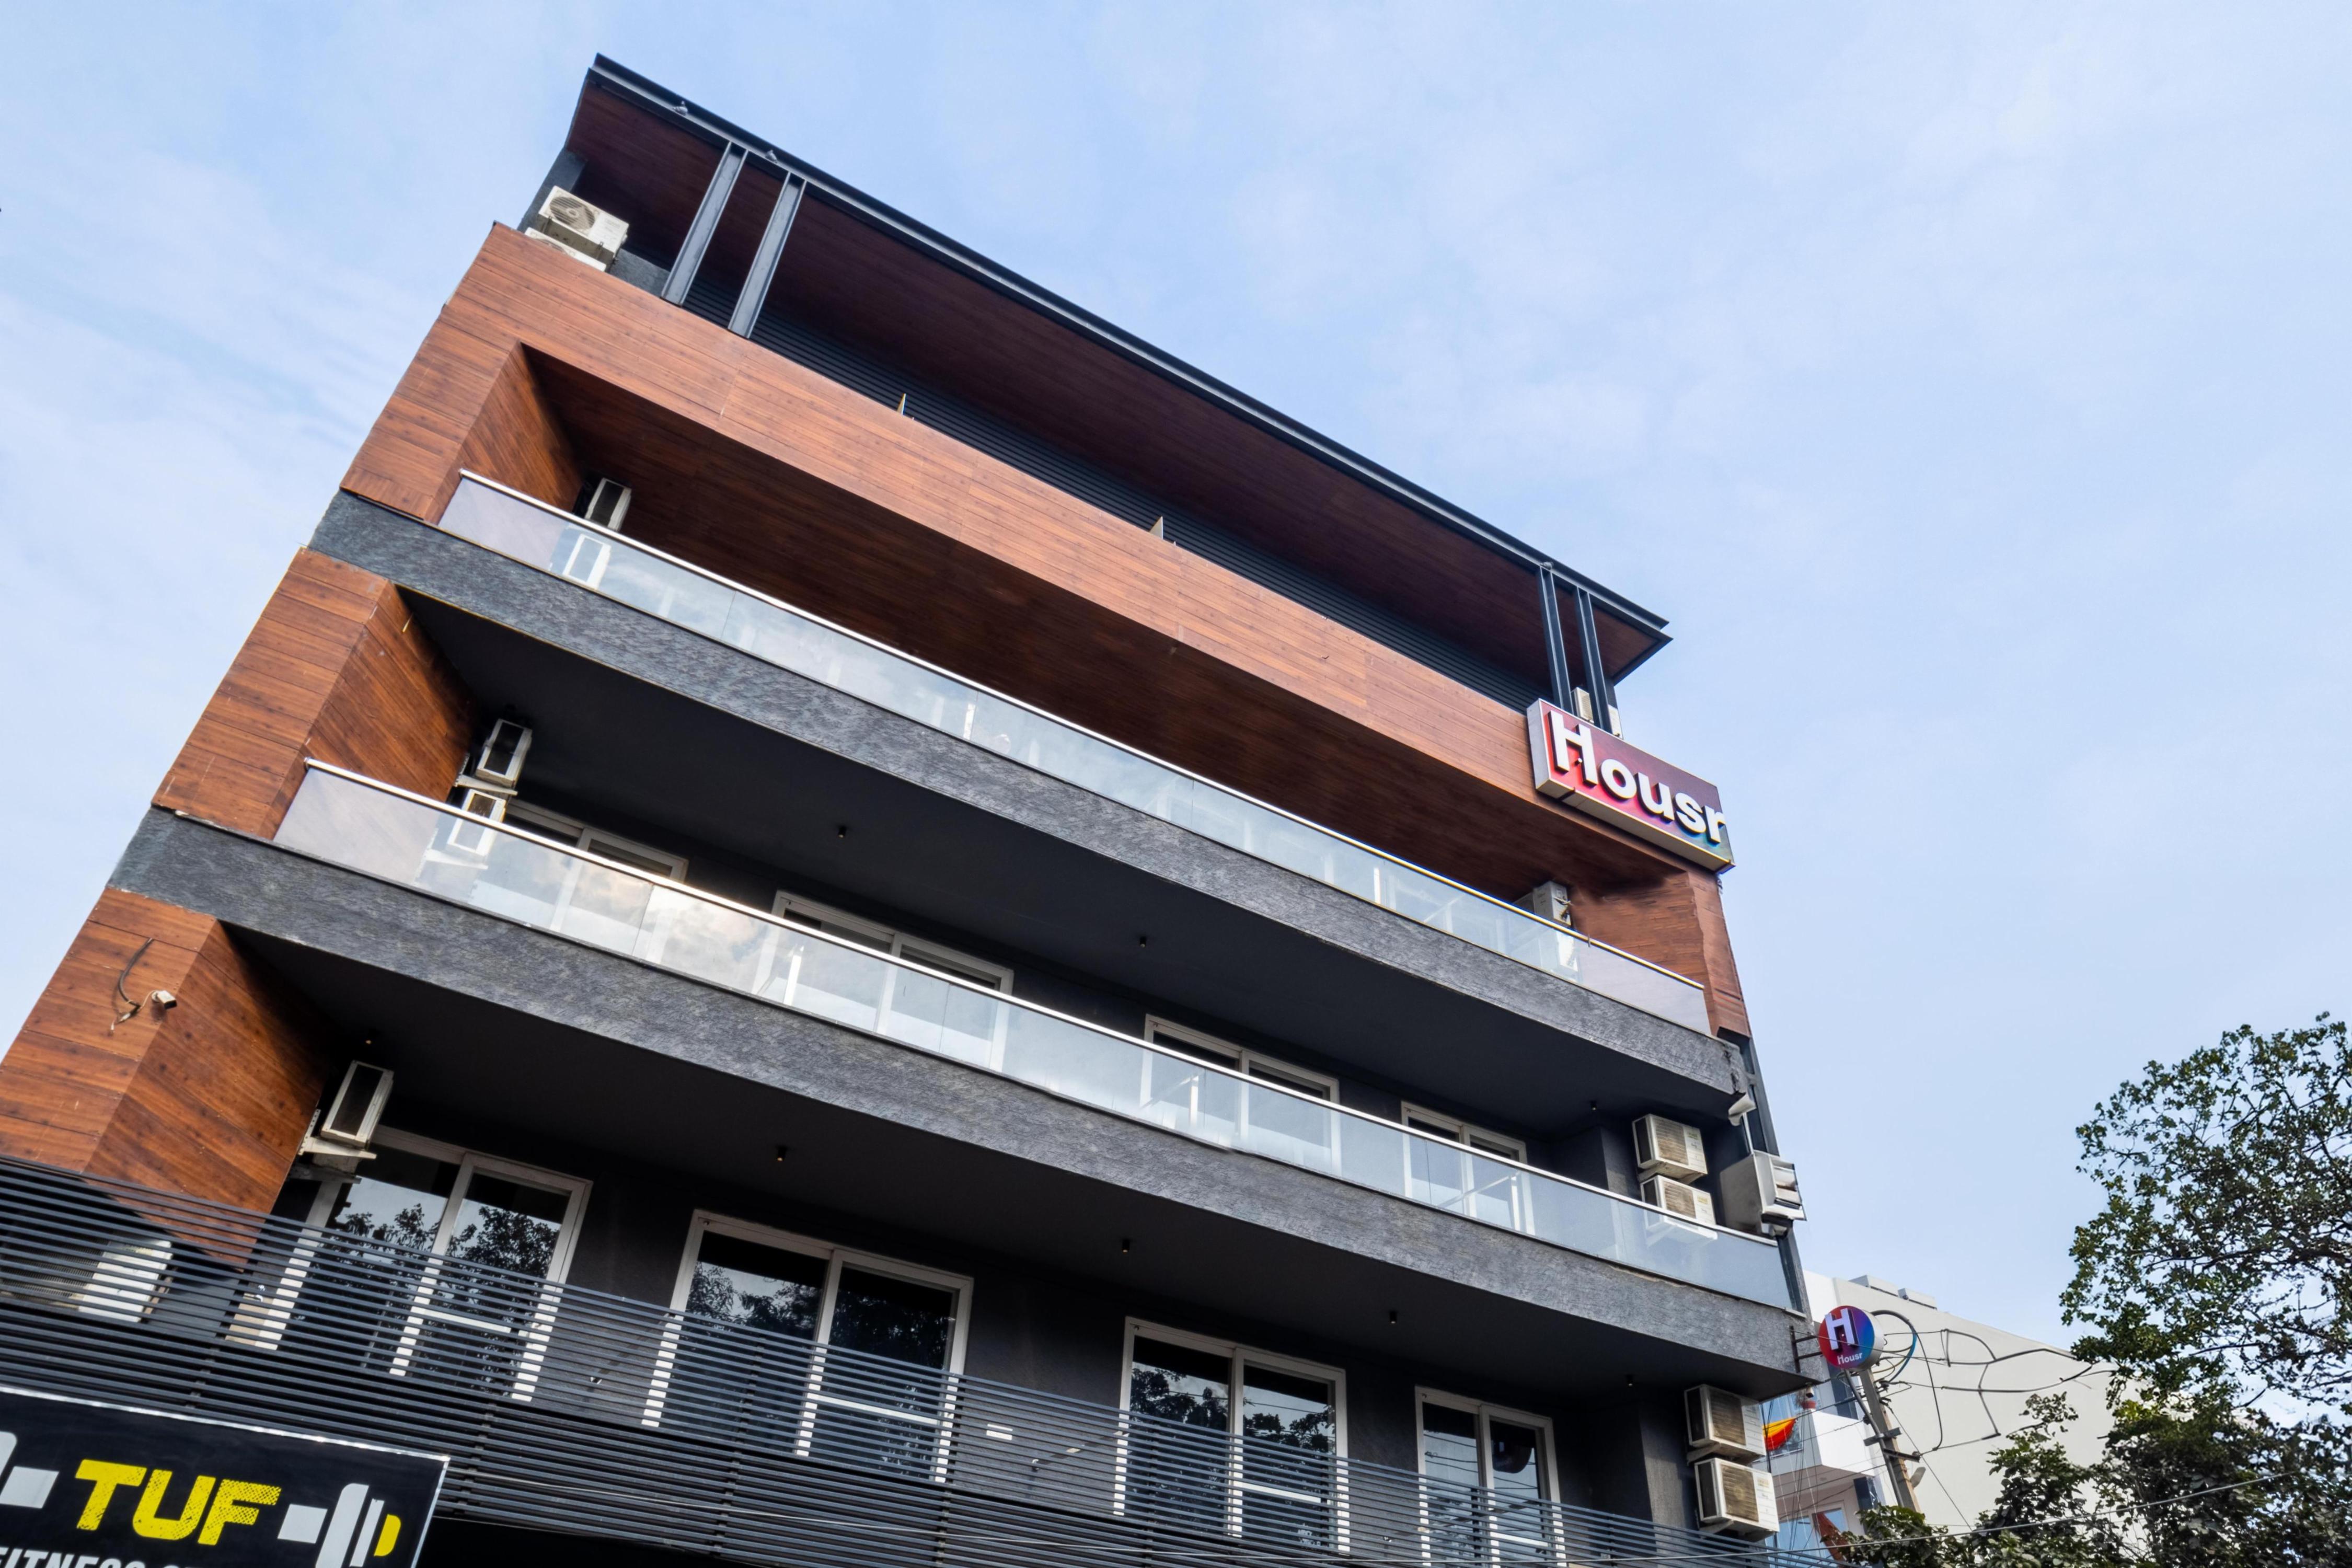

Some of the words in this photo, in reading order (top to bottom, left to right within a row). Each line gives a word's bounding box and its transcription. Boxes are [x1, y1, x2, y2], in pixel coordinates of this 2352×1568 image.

[1548, 710, 1726, 844] Housr
[1825, 1308, 1855, 1351] H
[1837, 1353, 1863, 1365] Housr
[75, 1459, 282, 1546] TUF
[0, 1547, 146, 1568] ITNE
